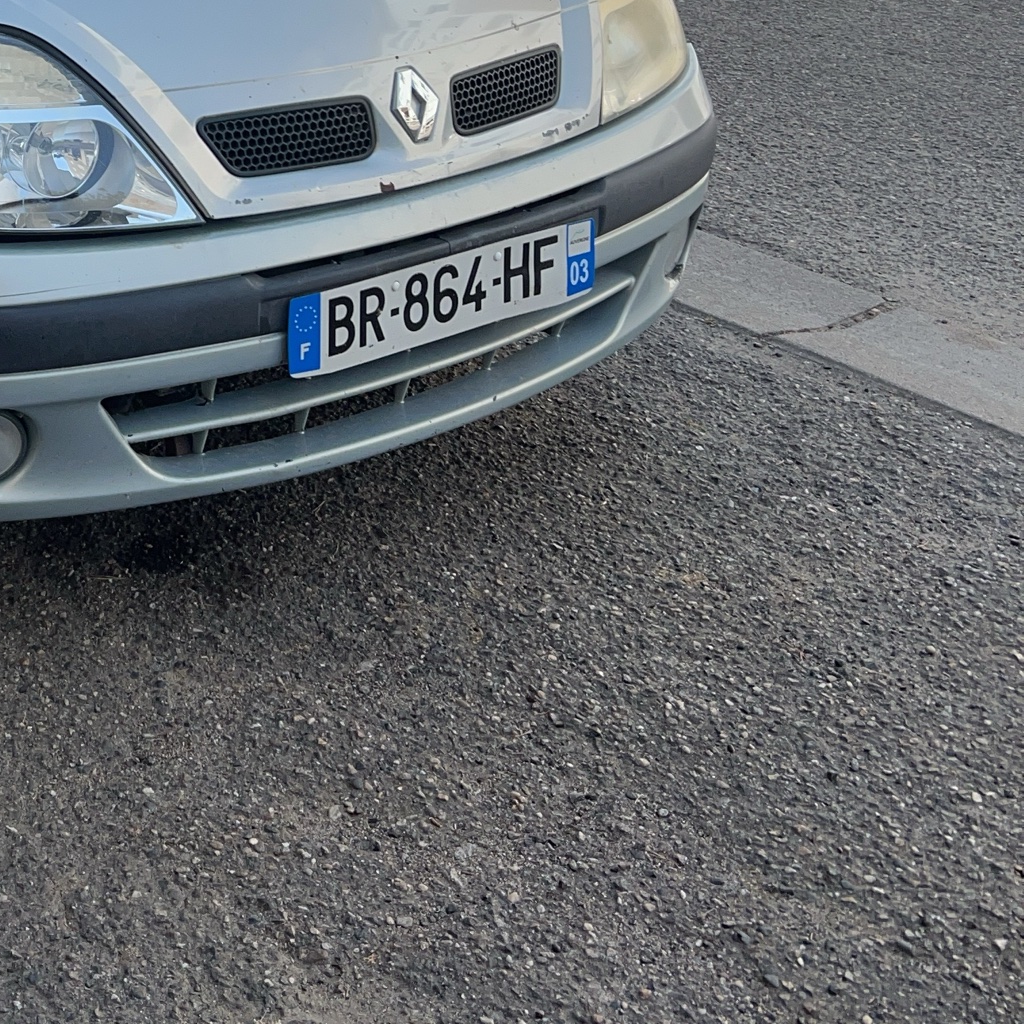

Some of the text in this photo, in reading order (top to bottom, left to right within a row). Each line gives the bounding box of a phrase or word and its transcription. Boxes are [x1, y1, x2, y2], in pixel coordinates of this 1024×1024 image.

[570, 258, 589, 286] 03
[328, 234, 559, 357] BR-864-HF
[299, 342, 312, 361] F
